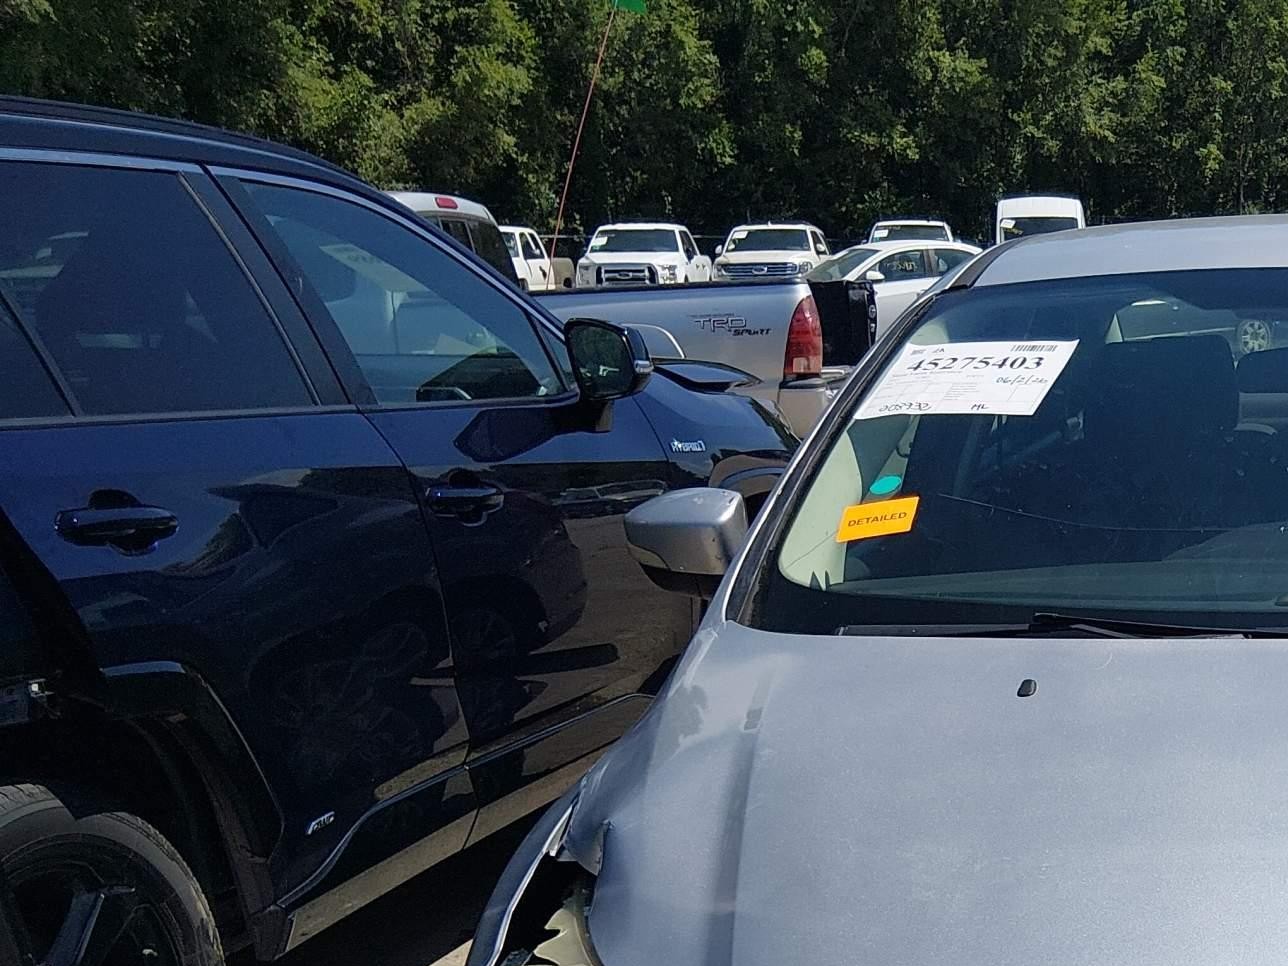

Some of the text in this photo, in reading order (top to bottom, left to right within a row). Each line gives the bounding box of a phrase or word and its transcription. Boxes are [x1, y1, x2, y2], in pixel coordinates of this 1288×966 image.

[694, 317, 747, 333] TRD
[906, 356, 1045, 372] 45275403
[848, 512, 907, 526] DETAILED
